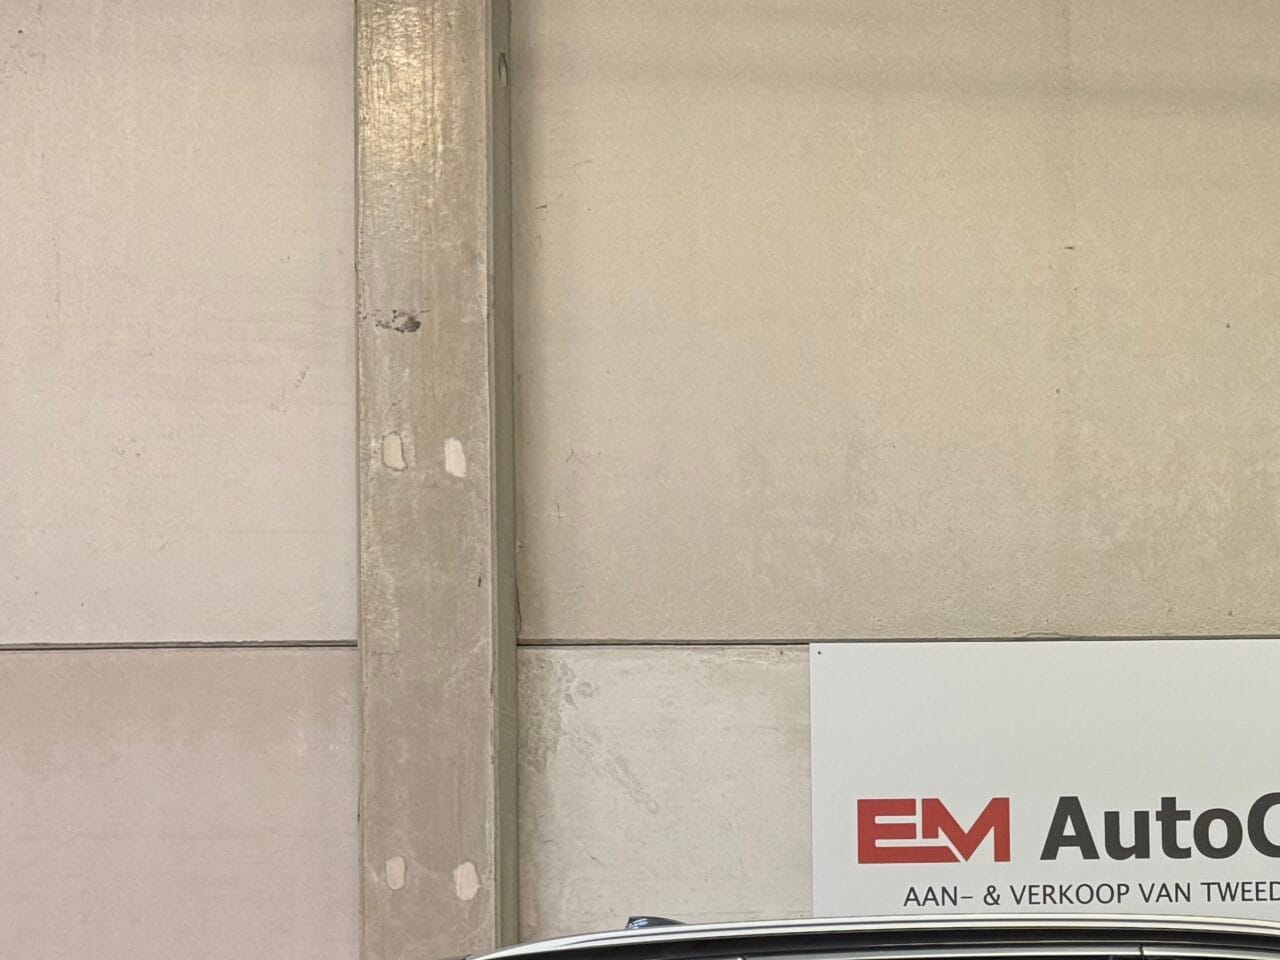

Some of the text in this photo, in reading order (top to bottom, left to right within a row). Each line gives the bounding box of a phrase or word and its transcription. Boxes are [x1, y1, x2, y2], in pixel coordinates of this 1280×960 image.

[858, 797, 1010, 864] EM
[983, 885, 1001, 906] &
[1010, 883, 1130, 905] VERKOOP
[1138, 882, 1191, 903] VAN
